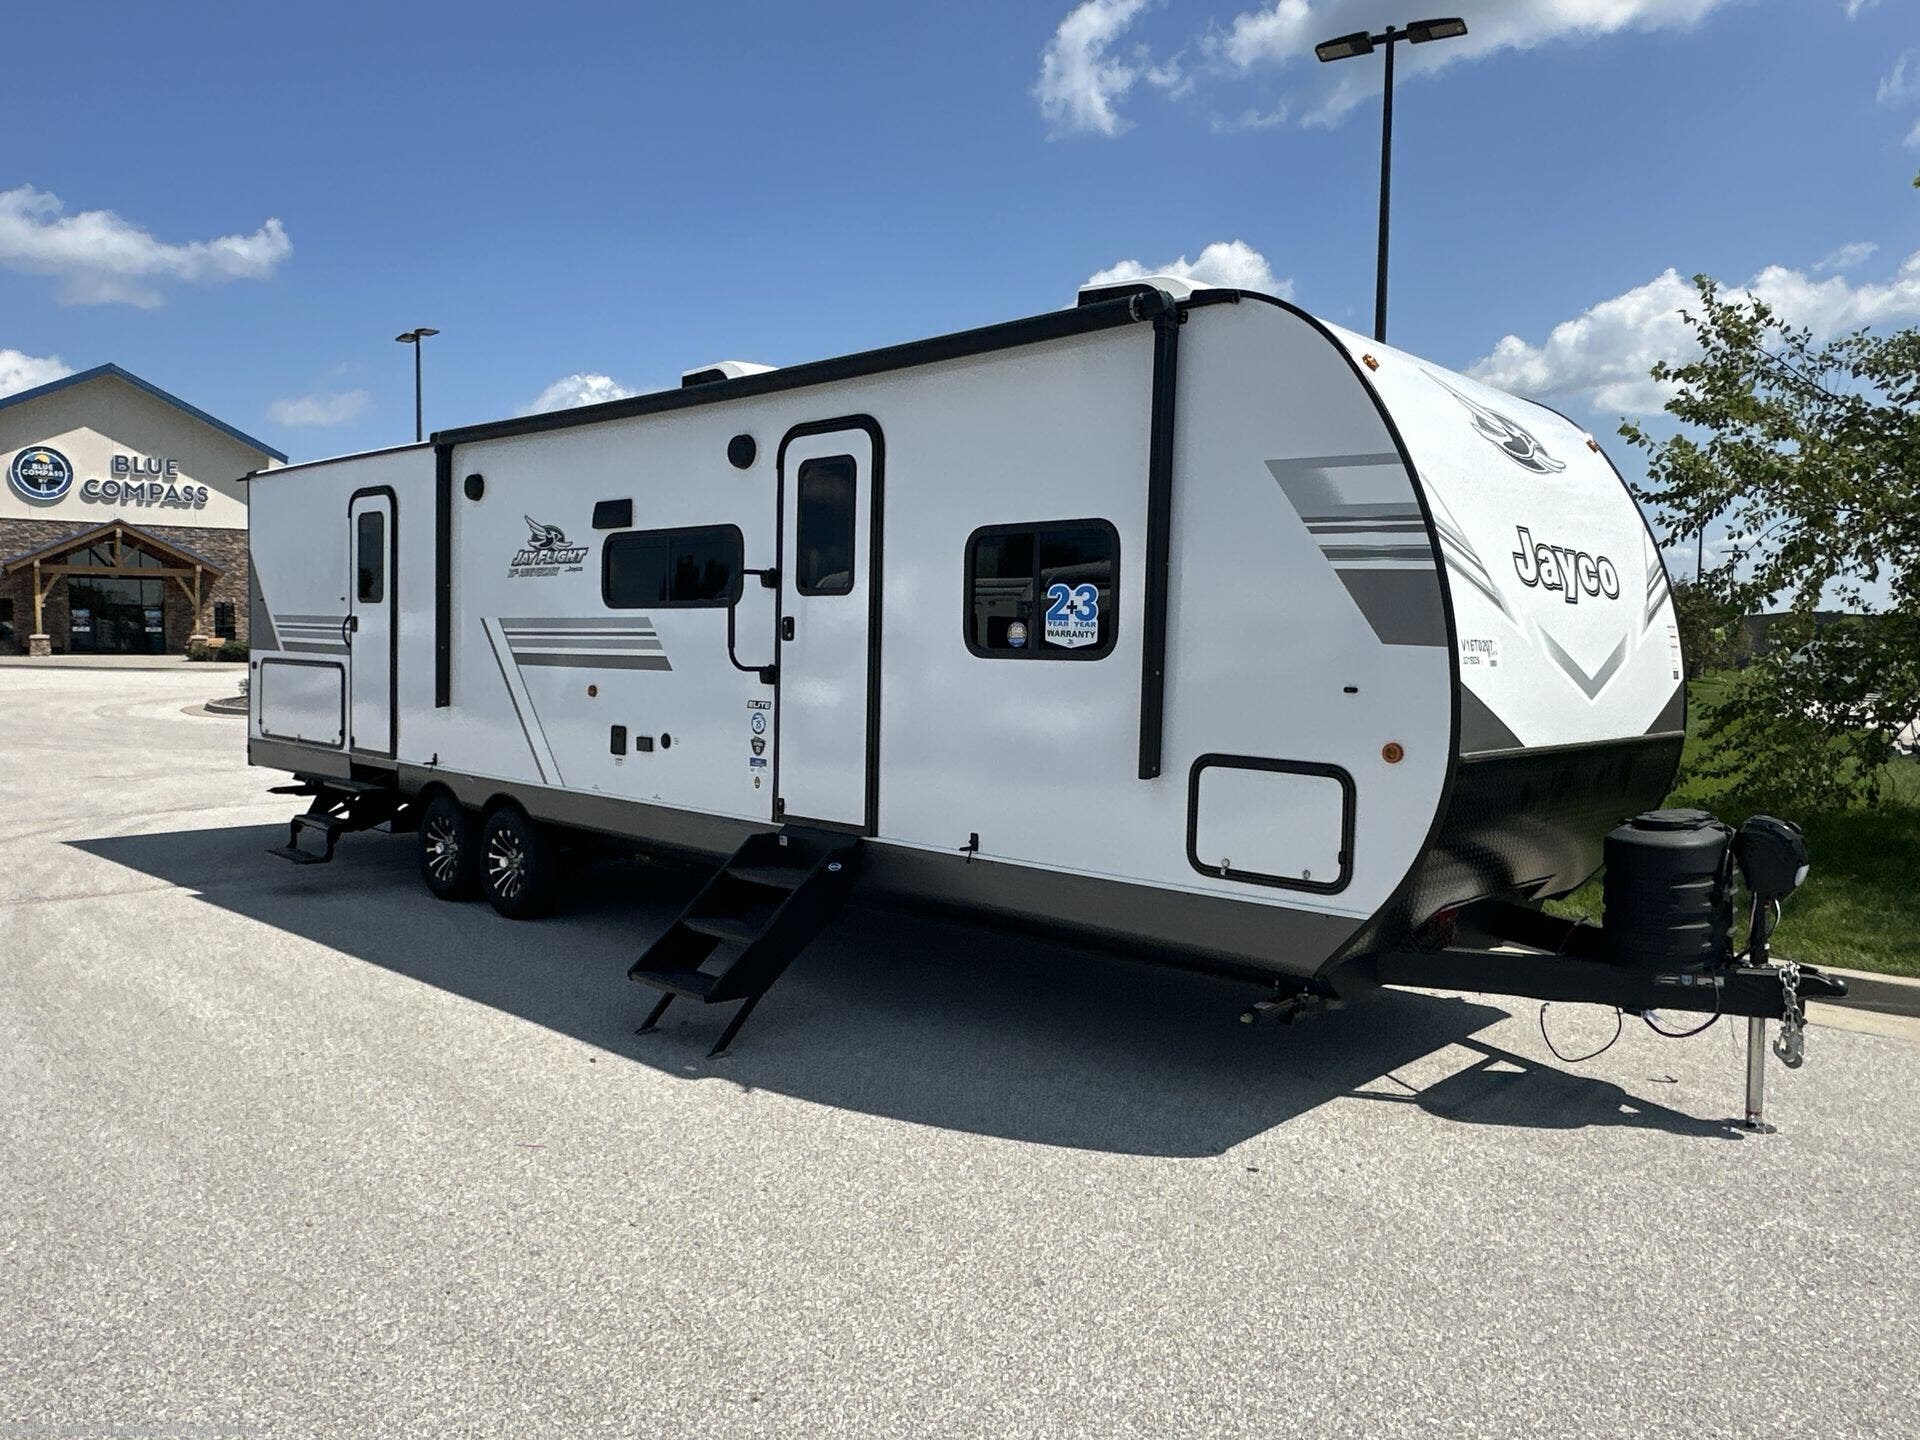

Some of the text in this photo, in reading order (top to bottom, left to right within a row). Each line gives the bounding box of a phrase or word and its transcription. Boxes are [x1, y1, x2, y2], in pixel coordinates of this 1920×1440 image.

[21, 468, 64, 477] COMPASS
[114, 455, 178, 477] BLUE
[83, 478, 209, 504] COMPASS
[1512, 525, 1620, 605] Jayco
[1046, 629, 1096, 638] WARRANTY
